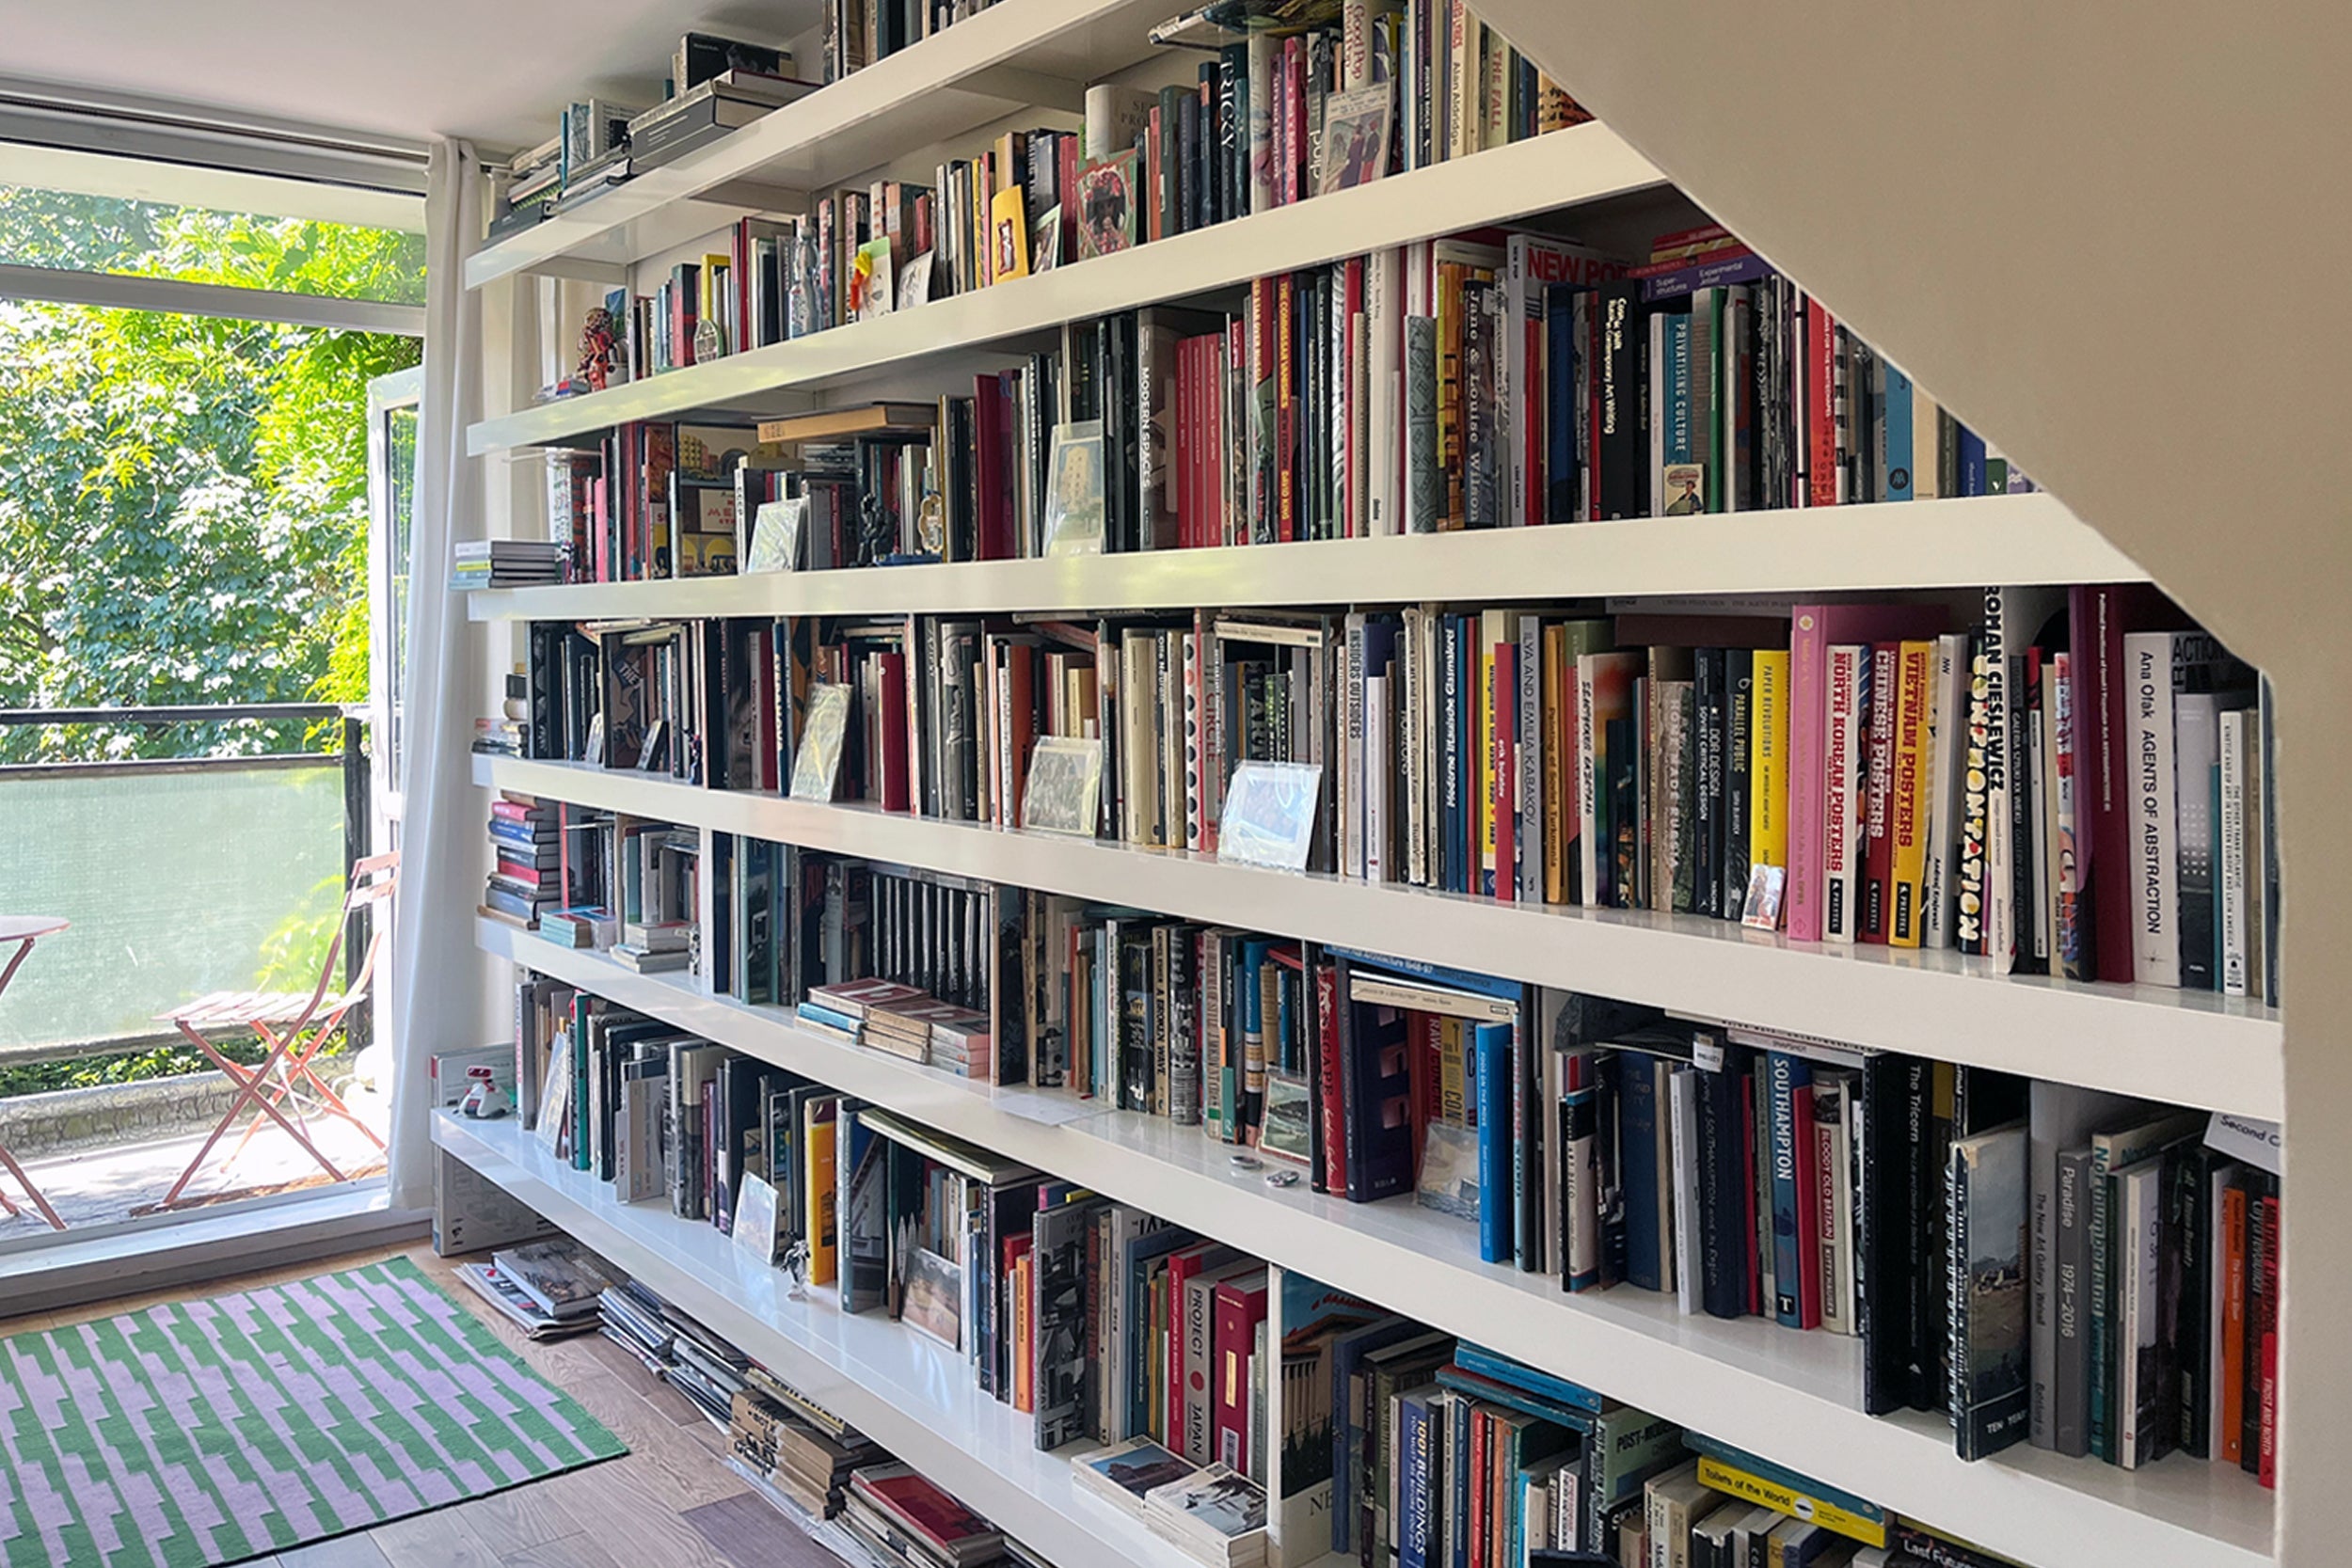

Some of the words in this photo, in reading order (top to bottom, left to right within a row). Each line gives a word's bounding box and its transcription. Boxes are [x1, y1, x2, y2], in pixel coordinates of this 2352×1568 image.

[1354, 5, 1365, 47] Good
[1351, 50, 1365, 80] Pop
[1453, 62, 1462, 90] Alan
[1492, 51, 1502, 83] THE
[1219, 55, 1234, 149] TRICKY
[1451, 92, 1463, 147] Aldridge
[1491, 89, 1502, 130] FALL
[1527, 247, 1581, 281] NEW
[1279, 281, 1289, 300] THE
[1279, 301, 1289, 360] COMMISSAR
[1470, 292, 1480, 340] Jane
[1470, 349, 1480, 364] &
[1603, 330, 1614, 383] Contemporary
[1675, 324, 1687, 396] PRIVATISING
[1141, 368, 1151, 429] MODERN
[1279, 361, 1289, 408] VANISHES
[1604, 384, 1614, 399] Art
[1470, 373, 1480, 443] Louise
[1603, 399, 1616, 434] Writing
[1675, 402, 1687, 451] CULTURE
[1141, 433, 1151, 488] SPACES
[1280, 470, 1290, 497] DAVID
[1470, 452, 1480, 522] Wilson
[1280, 499, 1290, 520] KING
[1523, 632, 1534, 661] ILYA
[1984, 585, 2002, 669] ROMAN
[1349, 630, 1362, 679] INSIDERS
[1445, 628, 1456, 695] Glasmalerei
[2141, 652, 2154, 679] Ana
[1523, 664, 1534, 697] AND
[1762, 665, 1772, 693] PAPER
[1833, 652, 1846, 712] NORTH
[1873, 650, 1889, 739] CHINESE
[1349, 681, 1362, 739] OUTSIDERS
[1733, 694, 1746, 736] PARALLEL
[1902, 652, 1919, 748] VIETNAM
[2142, 684, 2155, 719] Ofak
[1206, 693, 1216, 763] CIRCLE
[1523, 701, 1534, 752] EMILIA
[1547, 707, 1557, 752] Painting
[1699, 705, 1708, 740] SOVIET
[1762, 698, 1772, 758] REVOLUTIONS
[1988, 671, 2005, 791] CIESLEWICZ
[2011, 712, 2022, 749] GALERIA
[1699, 741, 1708, 783] CRITICAL
[1733, 739, 1746, 772] PUBLIC
[1833, 717, 1845, 788] KOREAN
[2012, 751, 2022, 780] SZTUKI
[2142, 730, 2157, 791] AGENTS
[1445, 755, 1456, 807] Moderne
[1524, 755, 1535, 827] KABAKOV
[1549, 772, 1558, 806] Soviet
[1670, 754, 1680, 800] MADE
[1709, 755, 1720, 797] DESIGN
[1870, 743, 1886, 838] POSTERS
[2013, 782, 2022, 794] XX
[1699, 785, 1708, 821] DESIGN
[1899, 752, 1916, 847] POSTERS
[2013, 796, 2023, 824] WIEKU
[2144, 797, 2158, 818] OF
[1549, 811, 1558, 867] Turkmenia
[1670, 807, 1680, 868] RUSSIA
[1831, 792, 1844, 872] POSTERS
[1931, 858, 1941, 889] Andrzej
[2144, 823, 2161, 934] ABSTRACTION
[1868, 893, 1878, 929] PRESTEL
[1898, 895, 1907, 932] PRESTEL
[1931, 892, 1940, 930] Krajewski
[1156, 988, 1166, 996] A
[1245, 972, 1254, 1030] Foundations
[1156, 999, 1166, 1043] BROKEN
[1157, 1045, 1167, 1075] WAVE
[1481, 1074, 1487, 1086] ON
[1909, 1066, 1921, 1089] The
[1774, 1058, 1793, 1180] SOUTHAMPTON
[1909, 1094, 1922, 1142] Tricorn
[2218, 1114, 2265, 1143] Second
[1820, 1130, 1832, 1171] BLOODY
[1567, 1172, 1576, 1199] DECO
[1822, 1174, 1833, 1196] OLD
[2035, 1193, 2046, 1211] The
[2062, 1167, 2075, 1227] Paradise
[1823, 1198, 1834, 1239] BRITAIN
[2035, 1212, 2046, 1234] New
[2090, 1147, 2110, 1312] Northumberland
[1088, 1227, 1099, 1263] ANIME
[1824, 1247, 1834, 1278] KITTY
[1088, 1267, 1099, 1360] ARCHITECTURE
[1825, 1279, 1836, 1315] HAUSER
[1191, 1288, 1202, 1358] PROJECT
[2262, 1378, 2273, 1402] FROST
[1191, 1402, 1203, 1454] JAPAN
[2262, 1404, 2272, 1424] AND
[1416, 1420, 1428, 1458] 1001
[2262, 1426, 2273, 1457] NORTH
[1704, 1466, 1733, 1488] Toilets
[1734, 1477, 1745, 1492] of
[1745, 1481, 1761, 1496] the
[1762, 1484, 1791, 1507] World
[1415, 1459, 1427, 1557] BUILDINGS
[1903, 1539, 1931, 1561] Last
